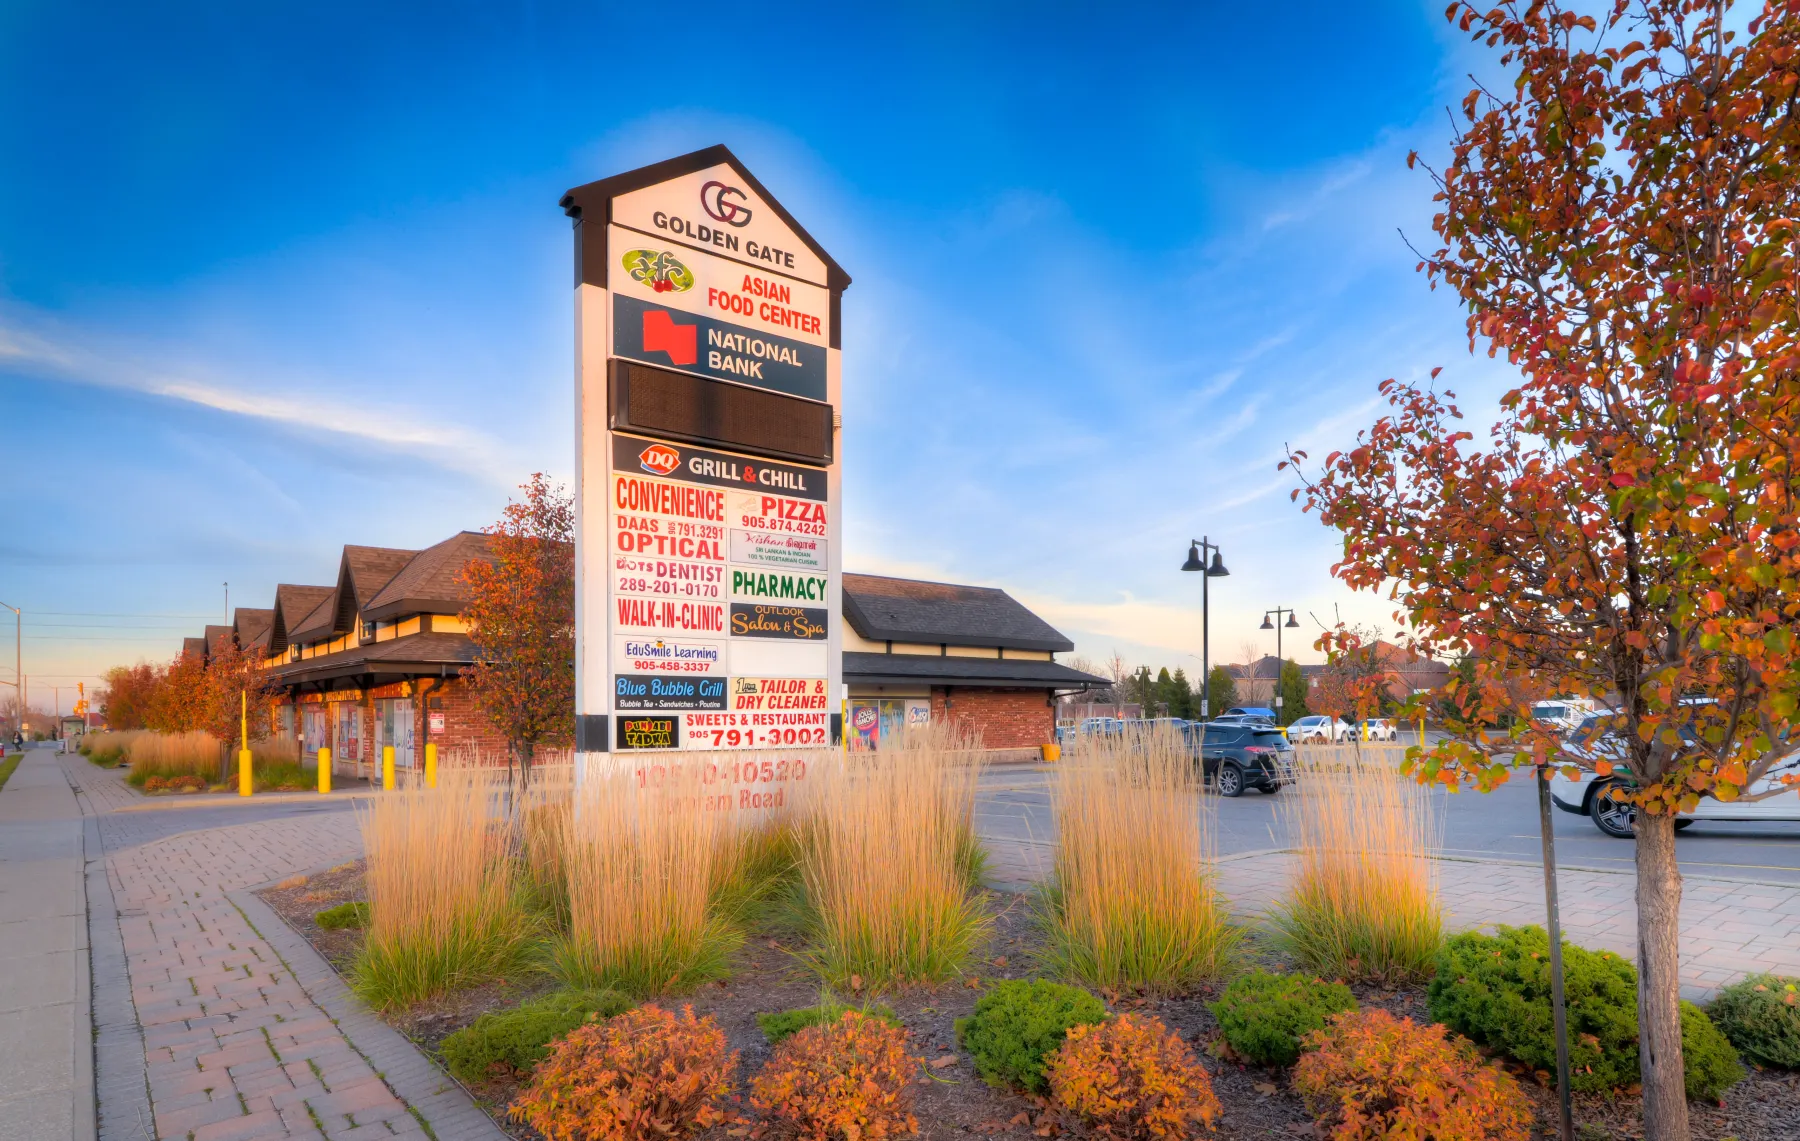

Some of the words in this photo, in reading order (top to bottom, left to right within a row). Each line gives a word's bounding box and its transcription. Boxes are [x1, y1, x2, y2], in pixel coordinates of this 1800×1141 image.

[653, 211, 739, 252] GOLDEN
[746, 240, 795, 270] GATE
[742, 274, 791, 304] ASIAN
[708, 287, 754, 317] FOOD
[759, 302, 821, 335] CENTER
[708, 328, 803, 367] NATIONAL
[708, 350, 763, 380] BANK
[646, 450, 674, 470] DQ
[688, 457, 741, 481] GRILL
[743, 465, 757, 483] &
[759, 468, 806, 491] CHILL
[616, 477, 724, 522] CONVENIENCE
[761, 496, 827, 525] PIZZA
[617, 515, 659, 533] DAAS
[677, 523, 723, 540] 791.3291
[668, 521, 676, 535] 905
[741, 515, 825, 536] 905.874.4242
[617, 531, 724, 561] OPTICAL
[745, 532, 784, 546] Kishan
[764, 547, 786, 555] LANKAN
[792, 550, 811, 558] INDIAN
[765, 554, 798, 564] VEGETARIAN
[798, 558, 818, 566] CUISINE
[656, 561, 723, 582] DENTIST
[619, 577, 718, 597] 289-201-0170
[732, 570, 827, 602] PHARMACY
[617, 598, 723, 632] WALK-IN-CLINIC
[755, 605, 804, 617] OUTLOOK
[731, 613, 780, 635] Salon
[784, 621, 791, 632] &
[793, 617, 825, 639] Spa
[626, 642, 672, 658] EduSmile
[674, 644, 718, 661] Learning
[634, 660, 710, 672] 905-458-3337
[616, 678, 646, 696] Blue
[651, 678, 694, 696] Bubble
[699, 679, 723, 697] Grill
[760, 680, 807, 694] TAILOR
[814, 680, 824, 694] &
[619, 699, 642, 708] Bubble
[643, 699, 654, 708] Tea
[659, 699, 694, 708] Sandwiches
[699, 699, 721, 708] Poutine
[736, 695, 765, 710] DRY
[767, 695, 827, 709] CLEANER
[686, 713, 737, 726] SWEETS
[740, 714, 749, 725] &
[753, 713, 826, 725] RESTAURANT
[858, 707, 873, 719] JOLLY
[625, 719, 672, 732] PUNJABI
[625, 732, 671, 747] TADKA
[689, 731, 709, 739] 905
[711, 728, 826, 746] 791-3002
[739, 788, 784, 810] Road
